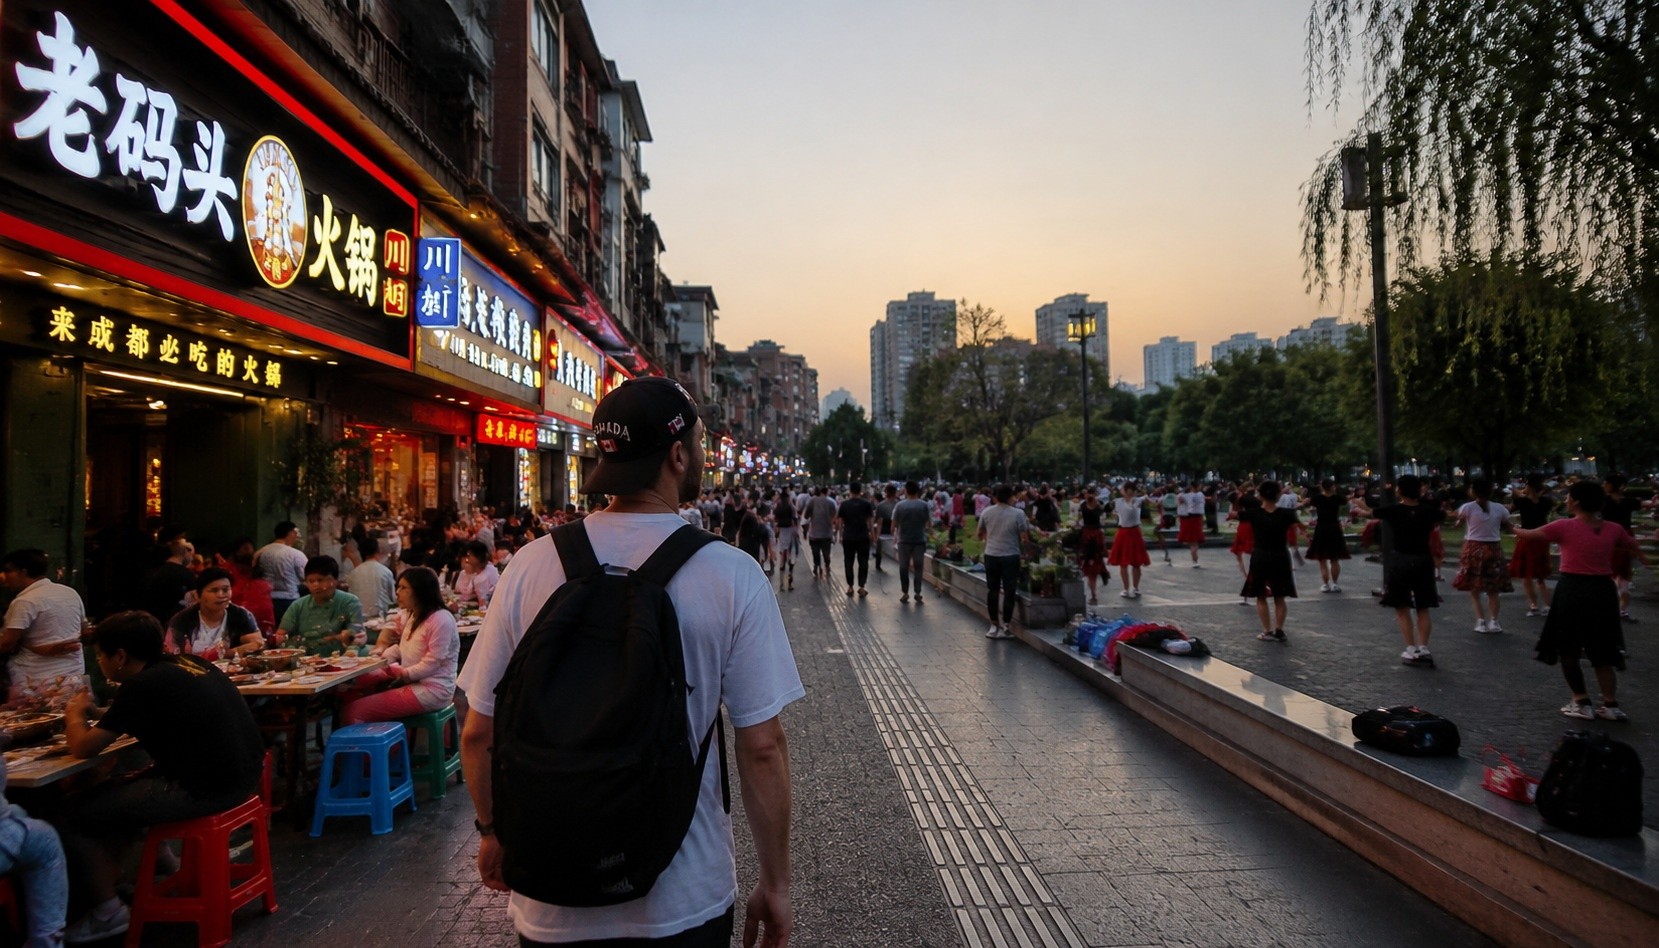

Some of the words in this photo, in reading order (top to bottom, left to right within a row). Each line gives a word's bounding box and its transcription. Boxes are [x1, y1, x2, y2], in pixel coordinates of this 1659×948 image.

[13, 11, 238, 243] 老码头
[307, 194, 379, 308] 火锅
